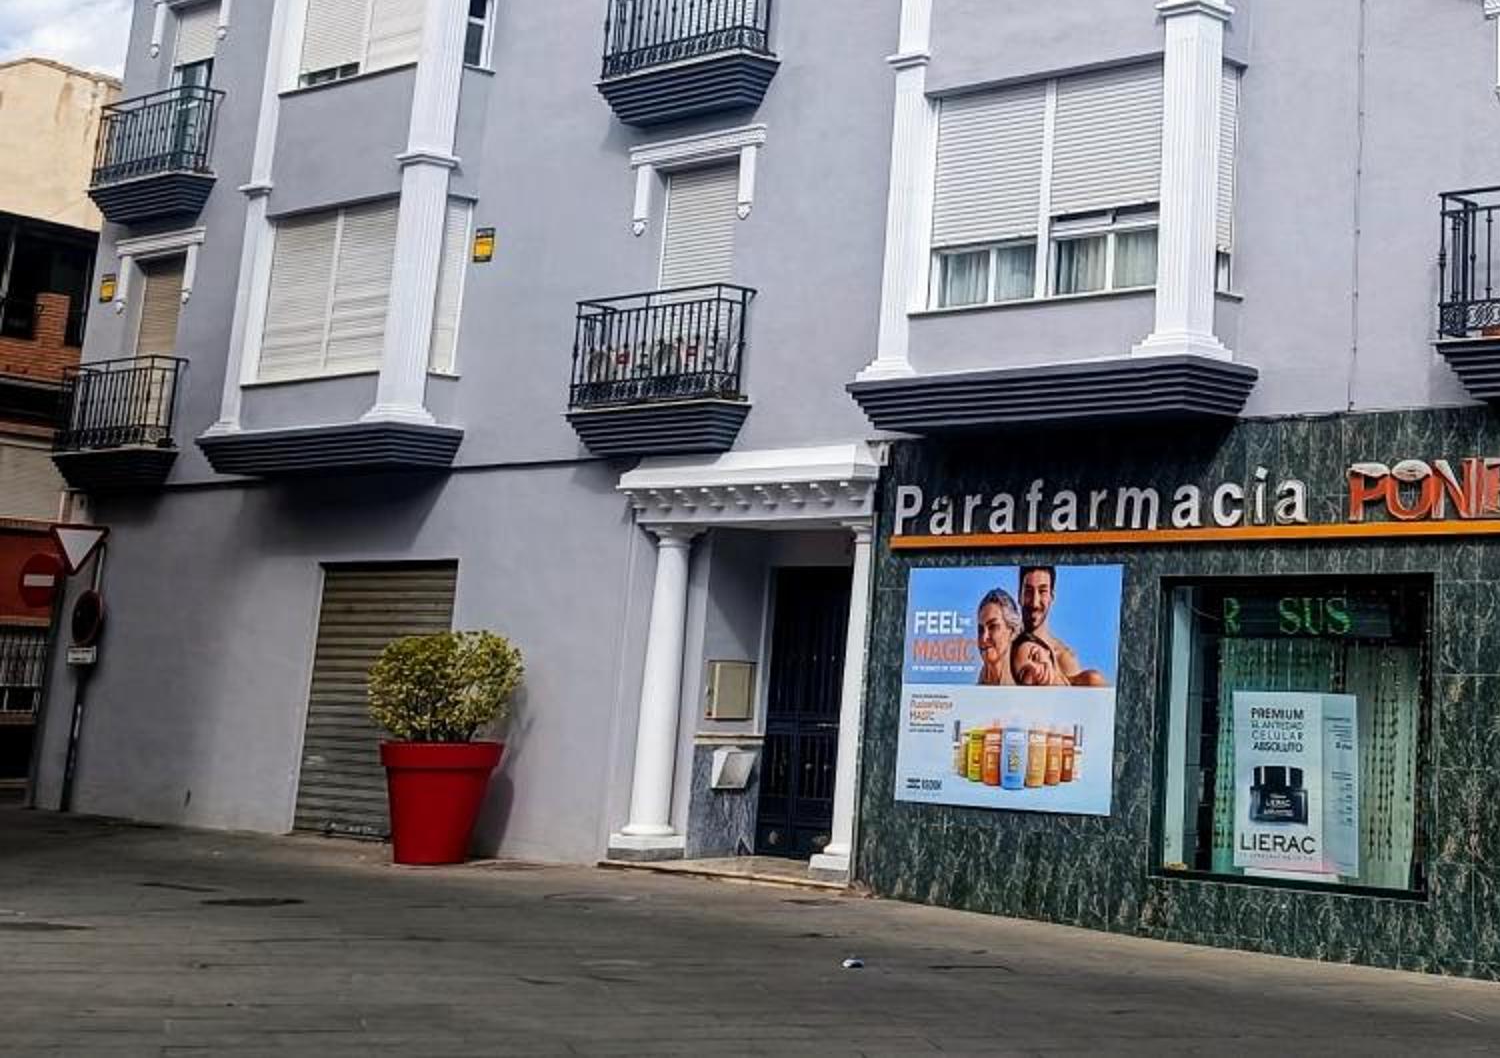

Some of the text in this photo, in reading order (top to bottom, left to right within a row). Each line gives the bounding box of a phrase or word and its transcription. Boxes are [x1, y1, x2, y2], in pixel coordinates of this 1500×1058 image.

[893, 466, 1310, 537] Parafarmacia
[914, 611, 963, 634] FEEL
[1279, 597, 1351, 635] SUS
[913, 638, 976, 662] MAGIC
[1251, 707, 1304, 719] PREMIUM
[1251, 730, 1304, 741] CELULAR
[1252, 741, 1304, 753] ABSOLUTO
[1239, 832, 1317, 855] LIERAC
